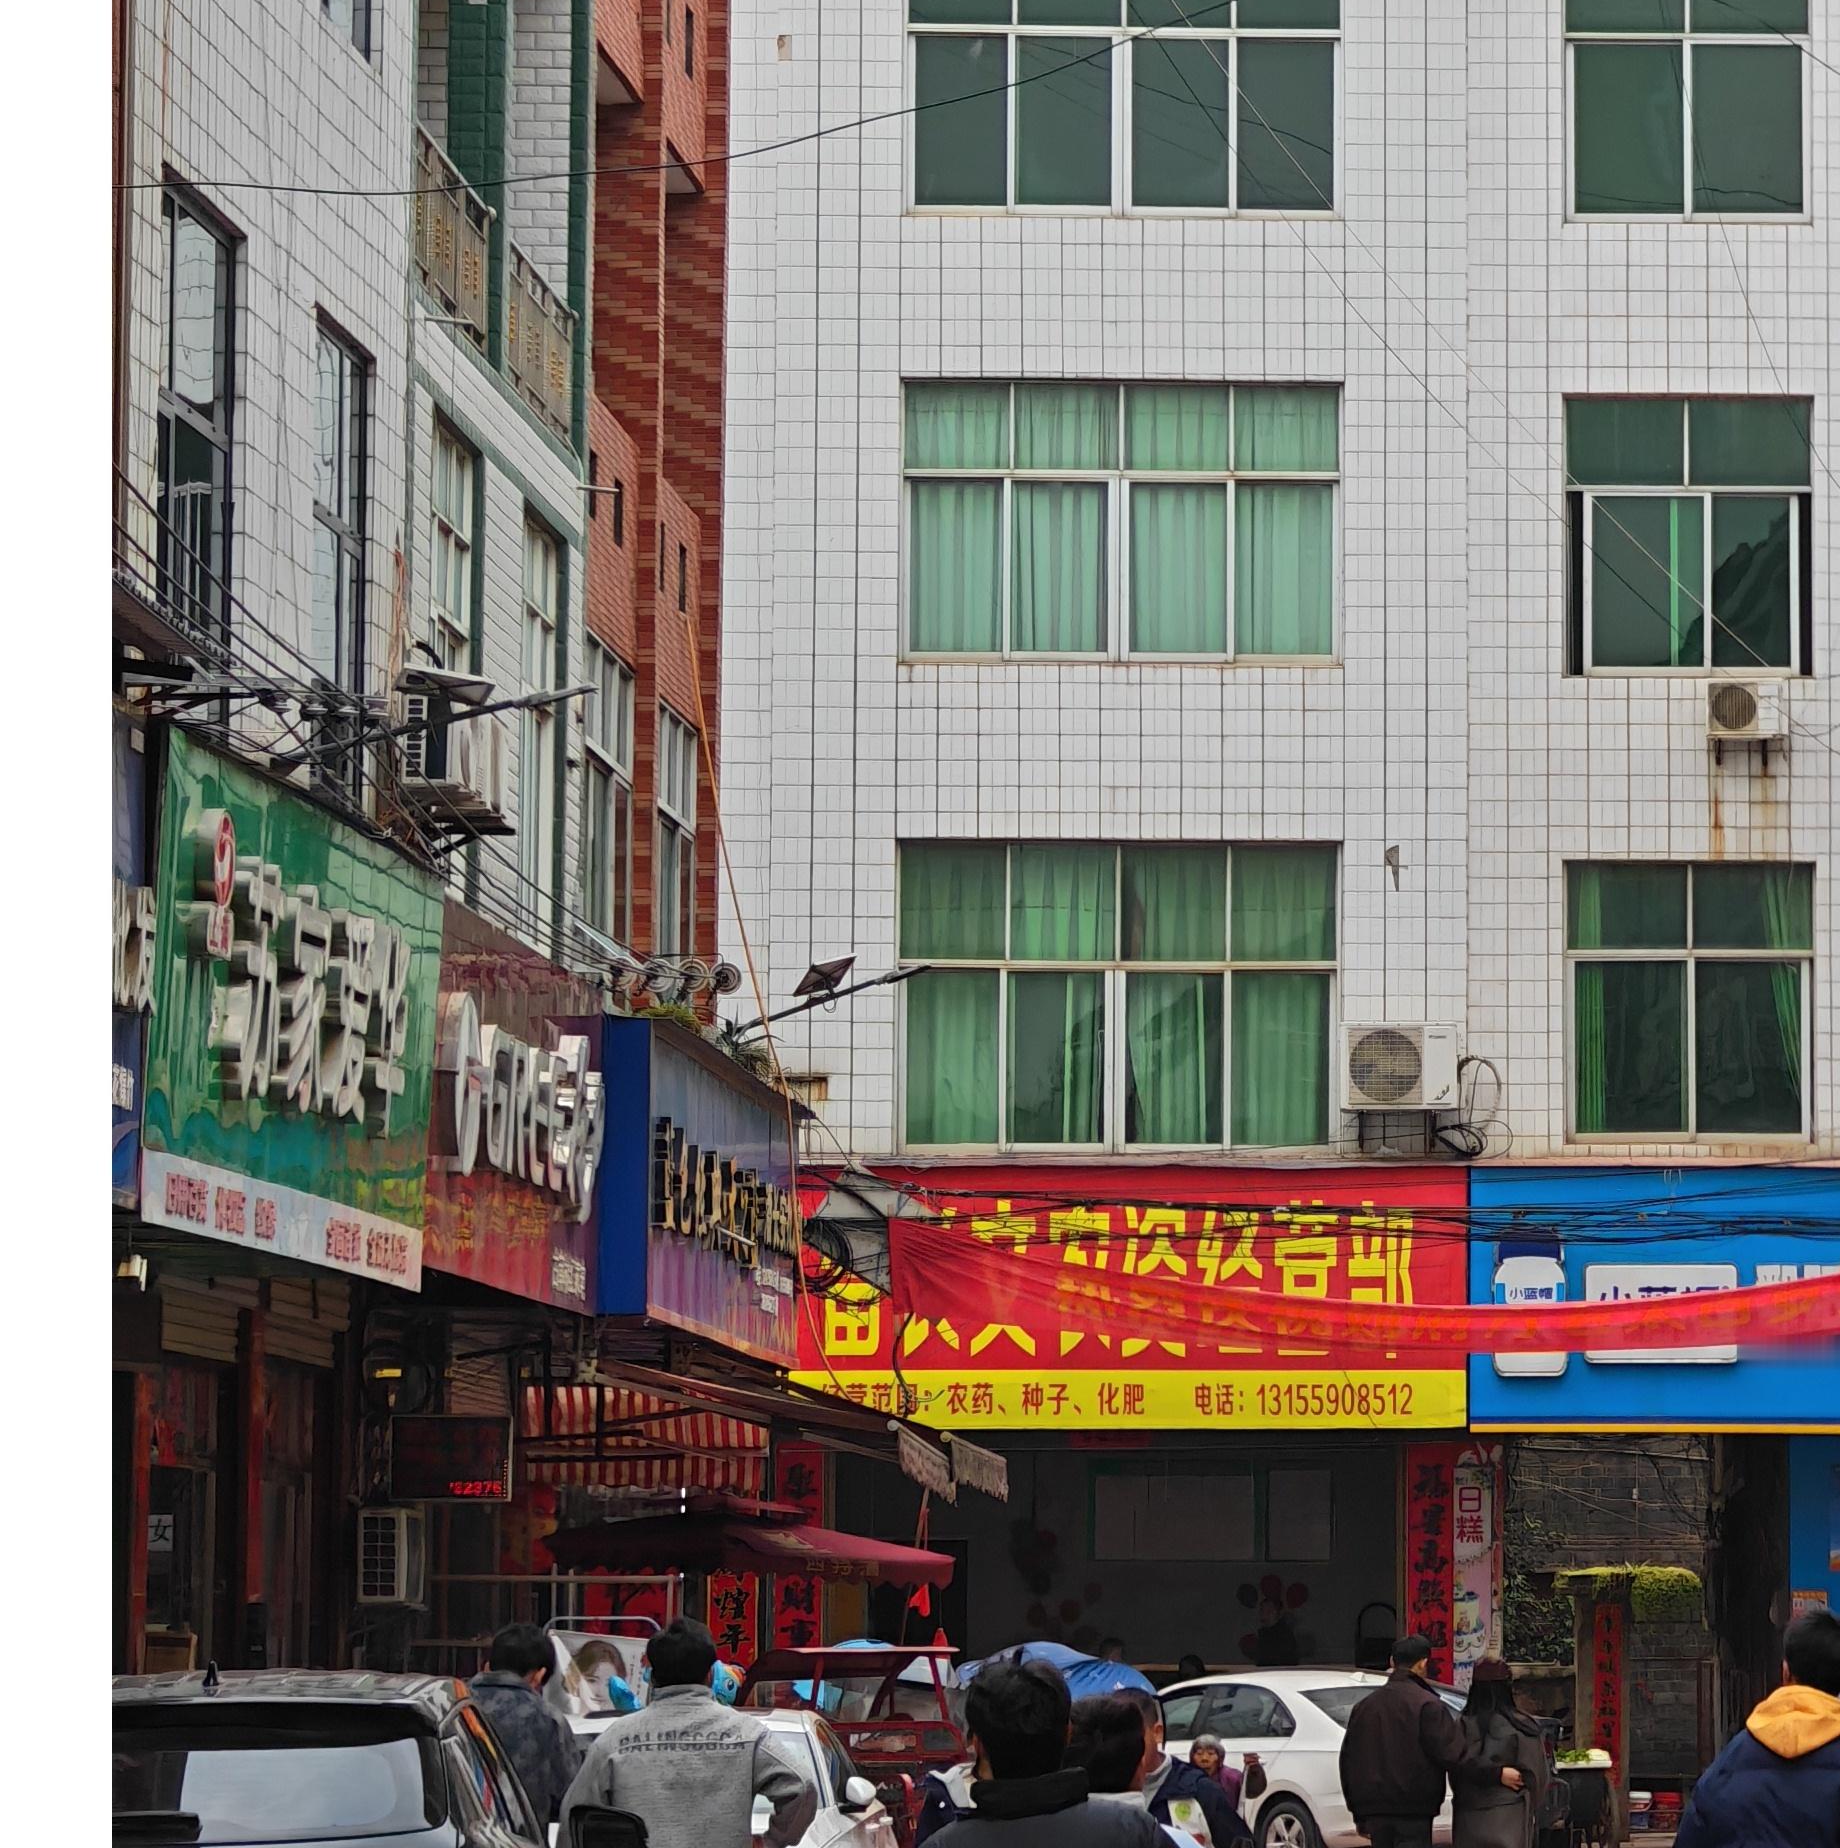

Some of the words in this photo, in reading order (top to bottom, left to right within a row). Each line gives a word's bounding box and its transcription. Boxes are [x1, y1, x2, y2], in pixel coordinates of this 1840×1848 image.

[1508, 1286, 1554, 1301] 小蓝帽
[148, 1518, 172, 1543] 女
